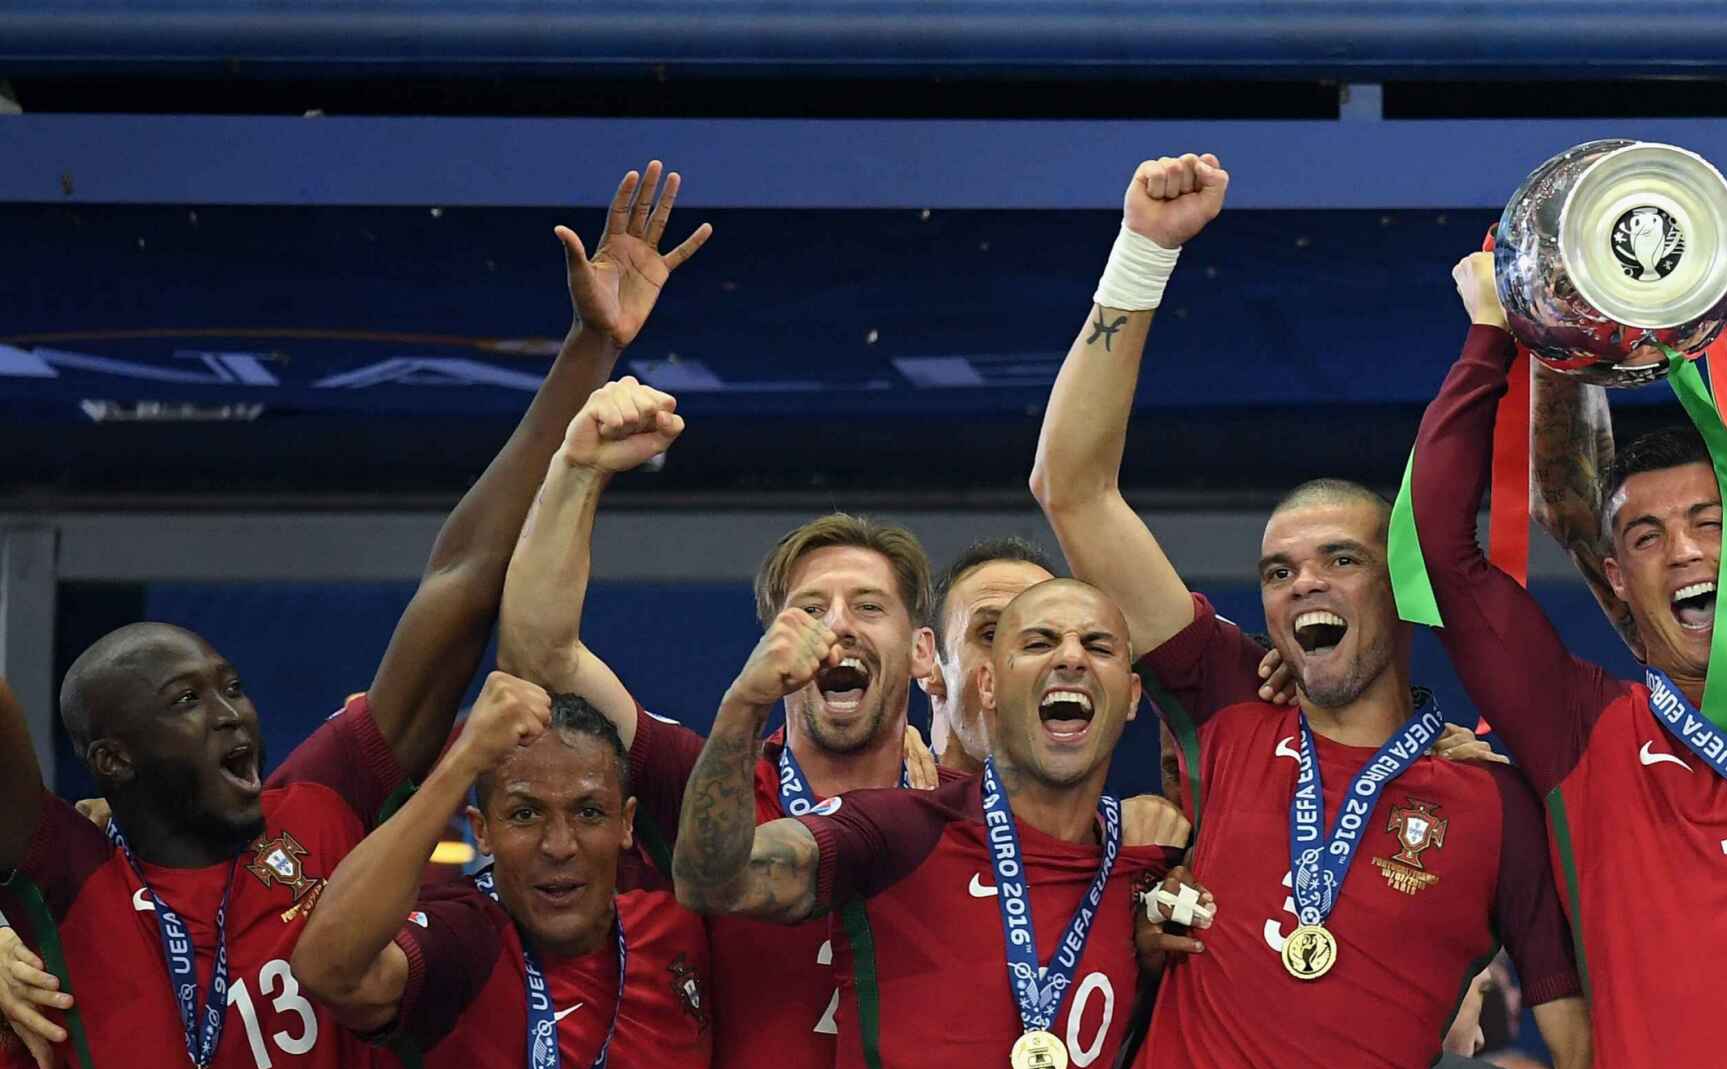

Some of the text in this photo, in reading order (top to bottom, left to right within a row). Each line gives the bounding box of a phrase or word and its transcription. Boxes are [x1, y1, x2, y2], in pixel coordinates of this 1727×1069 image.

[1296, 784, 1318, 842] UEFA
[1329, 711, 1442, 856] UEFA EURO 2016
[985, 810, 1019, 878] EURO
[1002, 882, 1031, 945] 2016
[1058, 909, 1093, 968] UEFA
[1089, 842, 1119, 906] EURO
[162, 911, 192, 974] UEFA
[523, 953, 549, 1011] UEF
